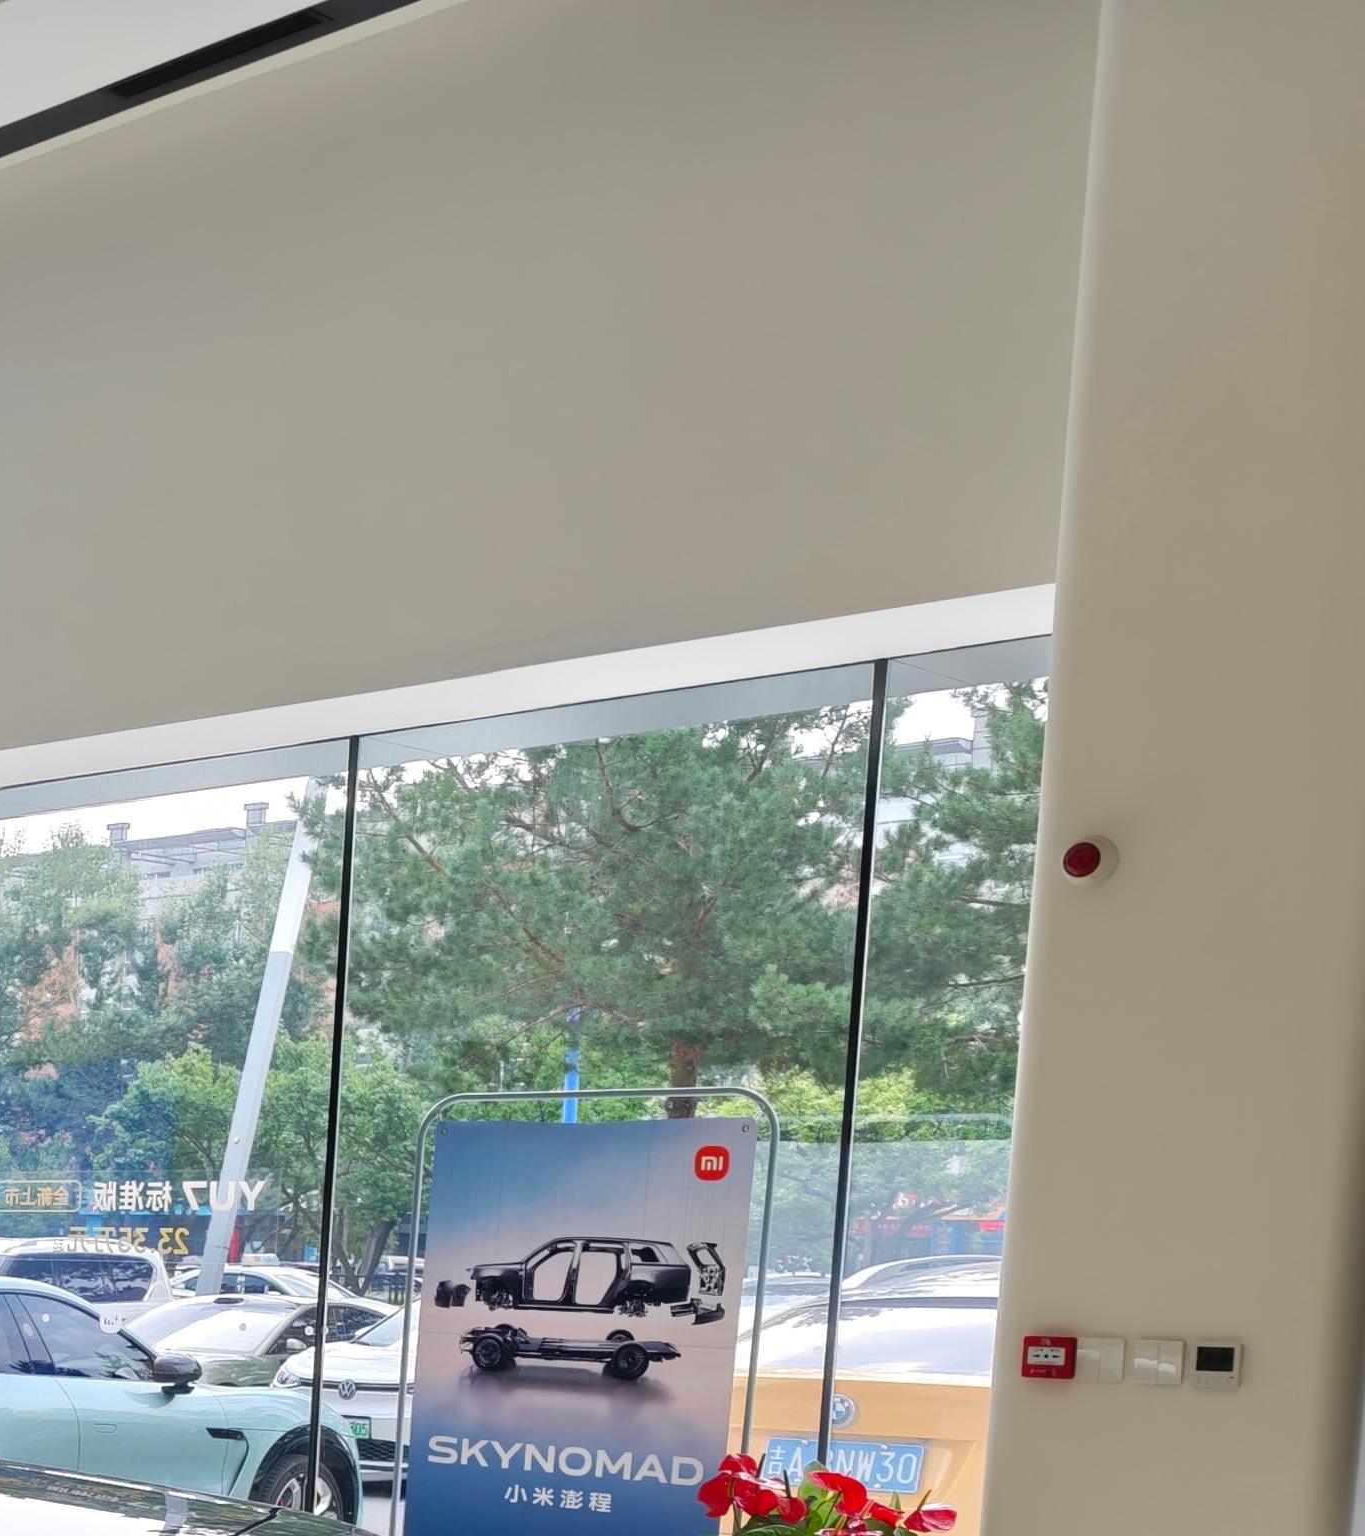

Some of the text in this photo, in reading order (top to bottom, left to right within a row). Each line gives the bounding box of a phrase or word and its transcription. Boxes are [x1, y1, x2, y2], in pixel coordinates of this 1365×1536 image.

[427, 1435, 705, 1487] SKYNOMAD
[504, 1484, 612, 1513] 小米澎程
